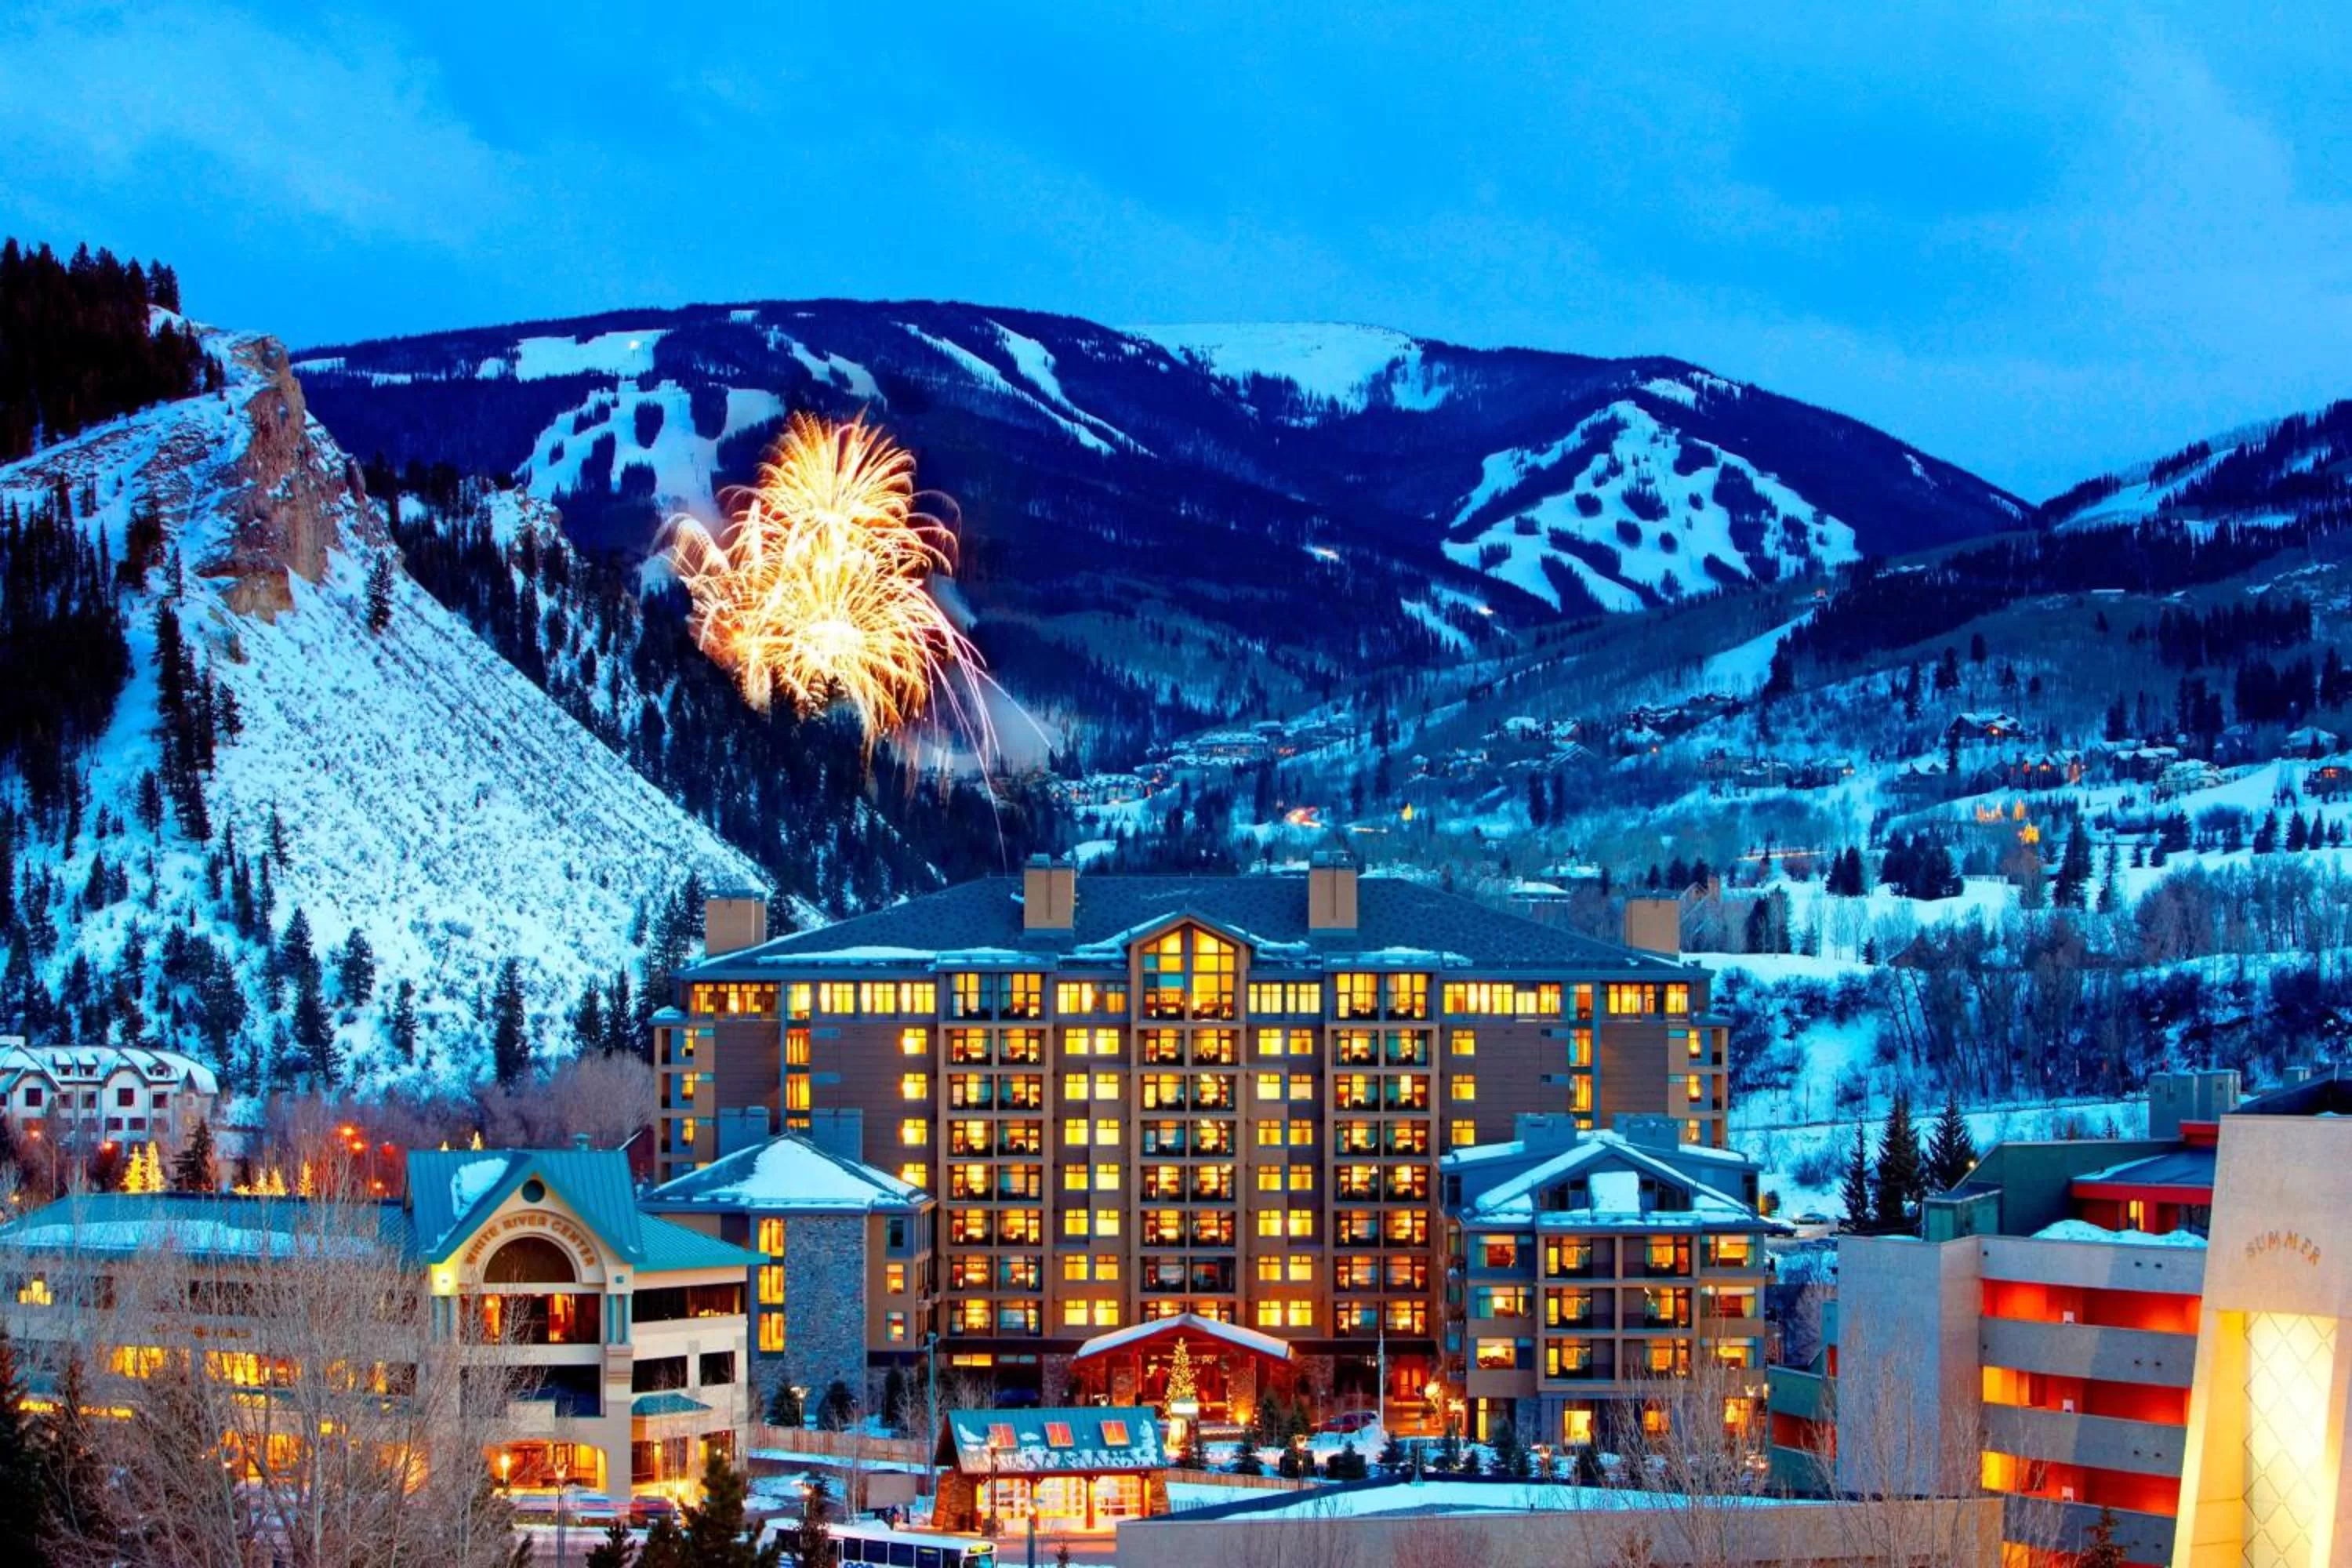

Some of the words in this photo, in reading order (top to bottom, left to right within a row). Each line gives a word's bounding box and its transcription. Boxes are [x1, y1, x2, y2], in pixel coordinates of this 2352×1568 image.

[465, 1225, 499, 1265] WHITE
[503, 1215, 547, 1230] RIVER
[551, 1220, 596, 1267] CENTER
[2245, 1229, 2321, 1266] SUMMER
